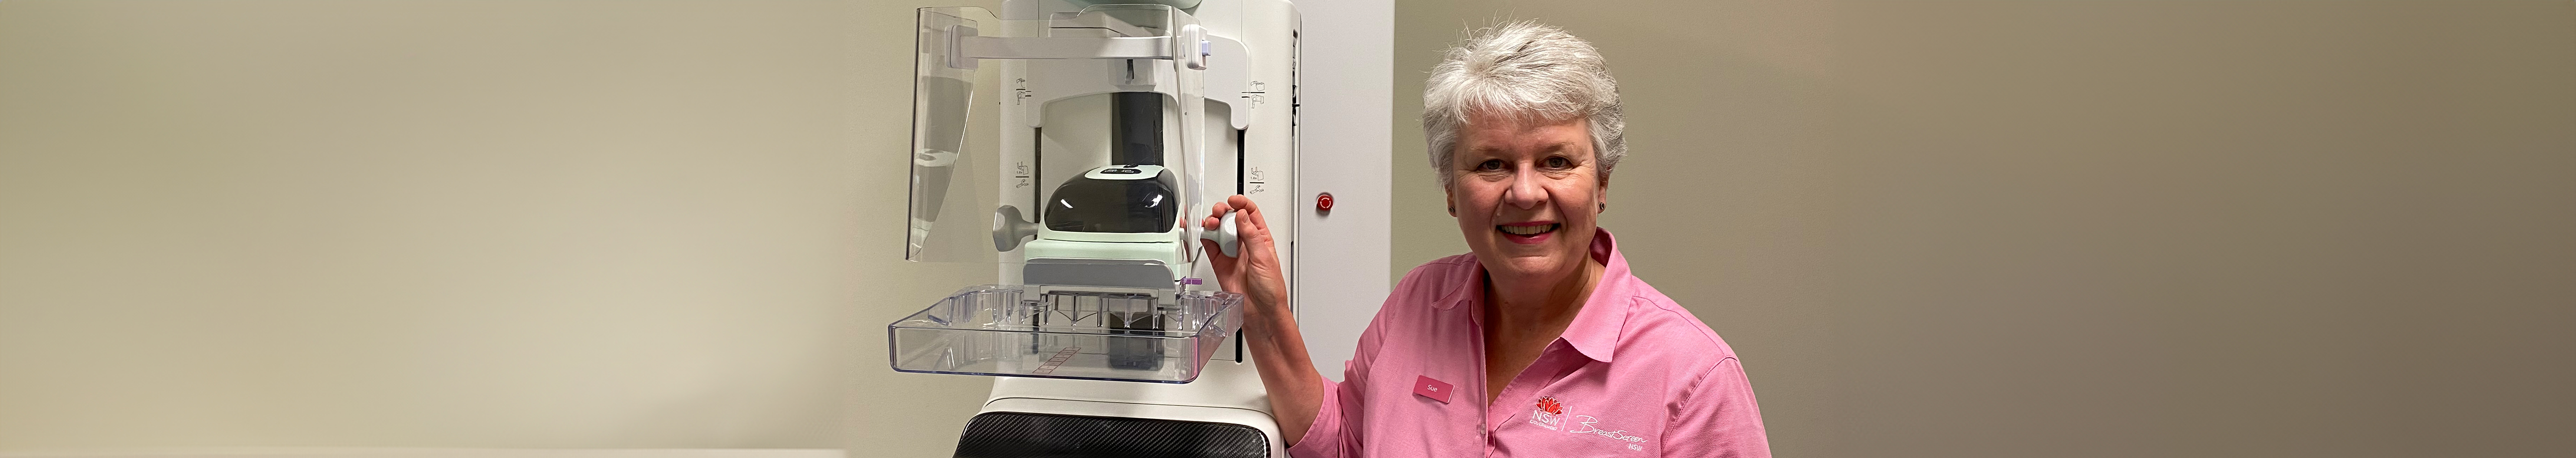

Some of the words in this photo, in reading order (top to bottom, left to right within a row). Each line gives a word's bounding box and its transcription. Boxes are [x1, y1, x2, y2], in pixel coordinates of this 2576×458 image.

[1427, 384, 1438, 392] Sue
[1532, 410, 1560, 426] NSW
[1530, 419, 1558, 430] GOVERNMENT
[1569, 415, 1648, 442] BreastScreen
[1628, 443, 1643, 451] NSW
